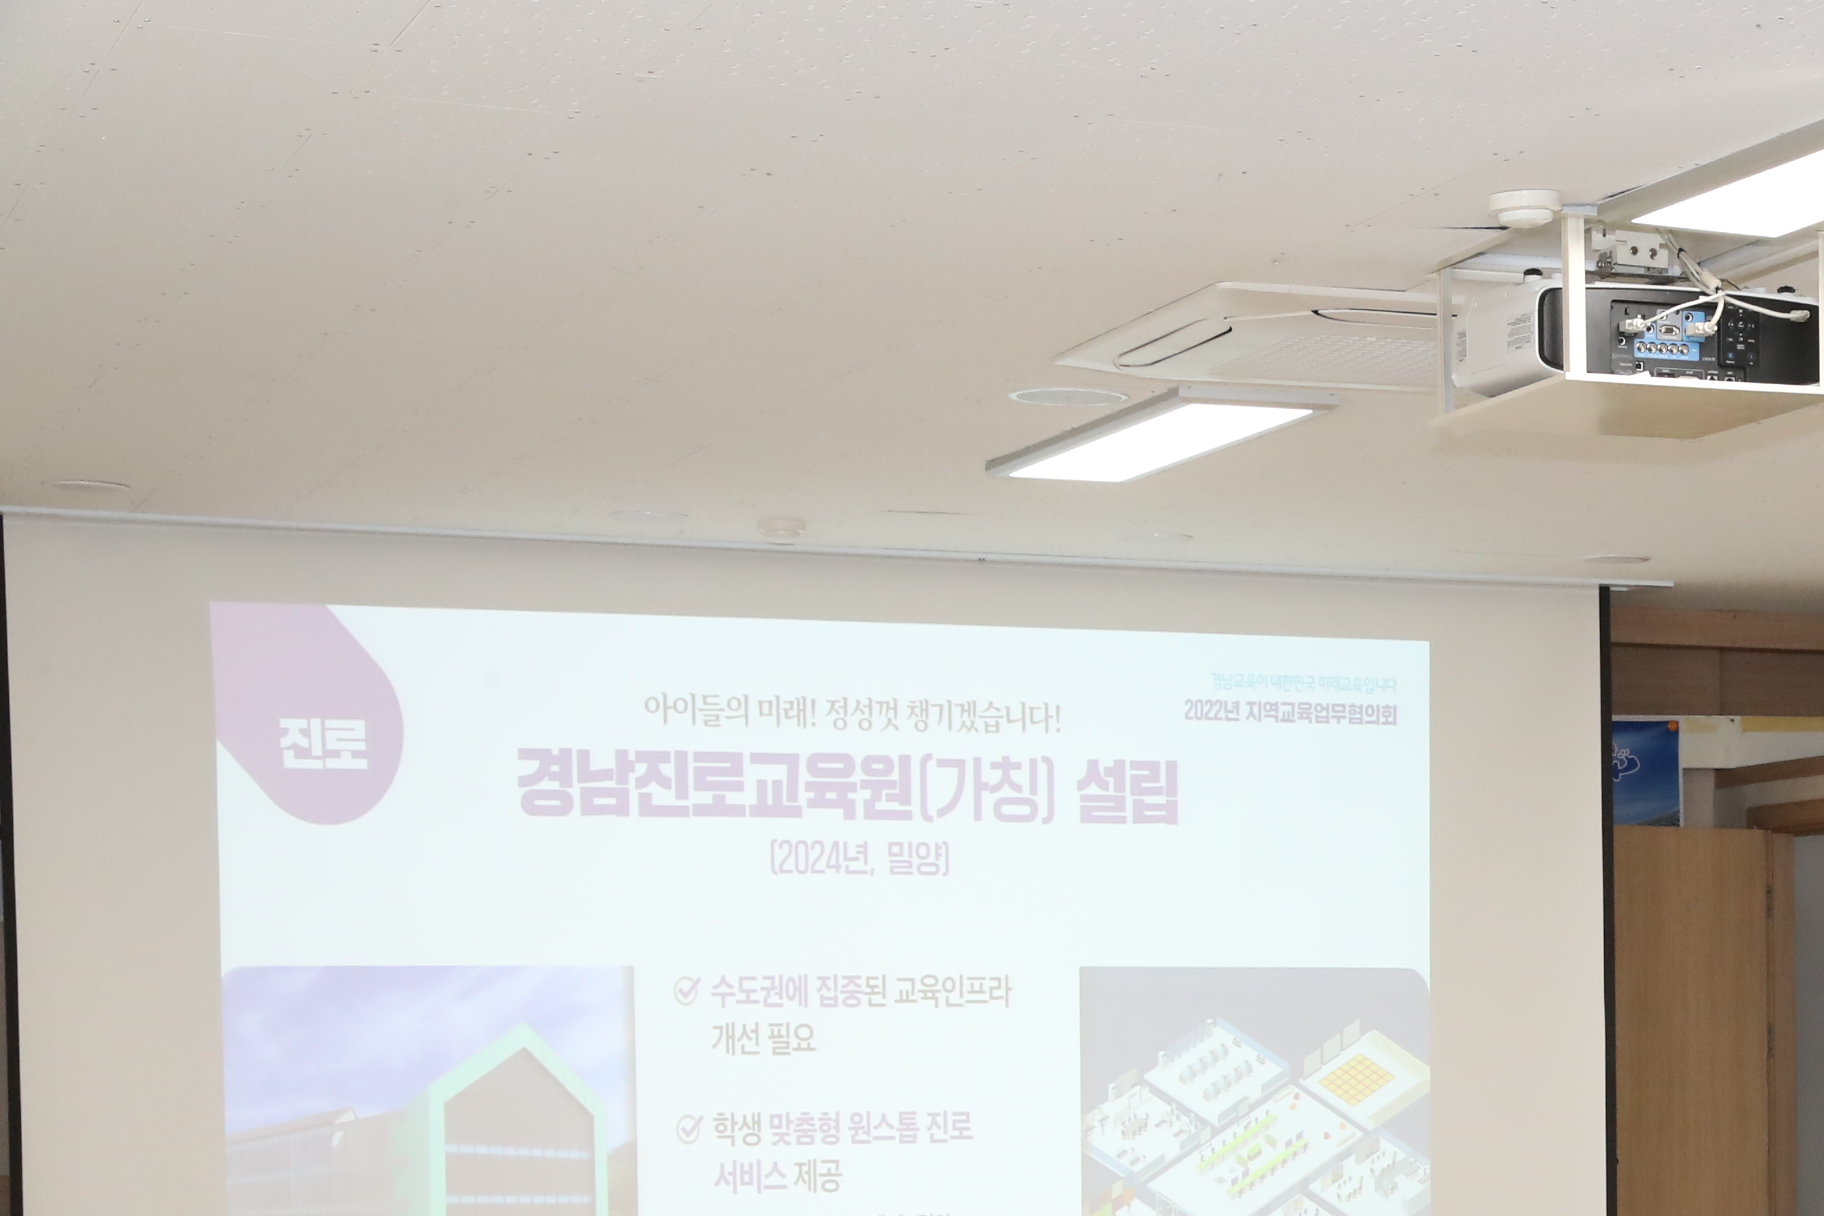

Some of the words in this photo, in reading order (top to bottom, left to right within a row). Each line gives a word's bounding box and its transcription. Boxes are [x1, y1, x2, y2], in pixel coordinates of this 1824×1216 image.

[1270, 674, 1316, 692] 대한민국
[1318, 676, 1397, 695] 미래교육입니다
[643, 691, 750, 727] 아이들의
[757, 693, 817, 729] 미래!
[825, 697, 901, 733] 정성껏
[906, 699, 1062, 735] 챙기겠습니다!
[1184, 698, 1241, 722] 2022년
[278, 716, 368, 770] 진로
[517, 746, 1055, 826] 경남진로교육원(가칭)
[1076, 757, 1180, 827] 설립
[710, 973, 809, 1008] 수도권에
[815, 973, 888, 1008] 집중된
[893, 973, 1013, 1008] 교육인프라
[711, 1021, 760, 1056] 개선
[767, 1021, 817, 1056] 필요
[712, 1111, 763, 1147] 학생
[768, 1110, 841, 1147] 맞춤형
[847, 1110, 920, 1145] 원스톱
[925, 1110, 974, 1144] 진로
[713, 1158, 788, 1194] 서비스
[793, 1157, 843, 1193] 제공
